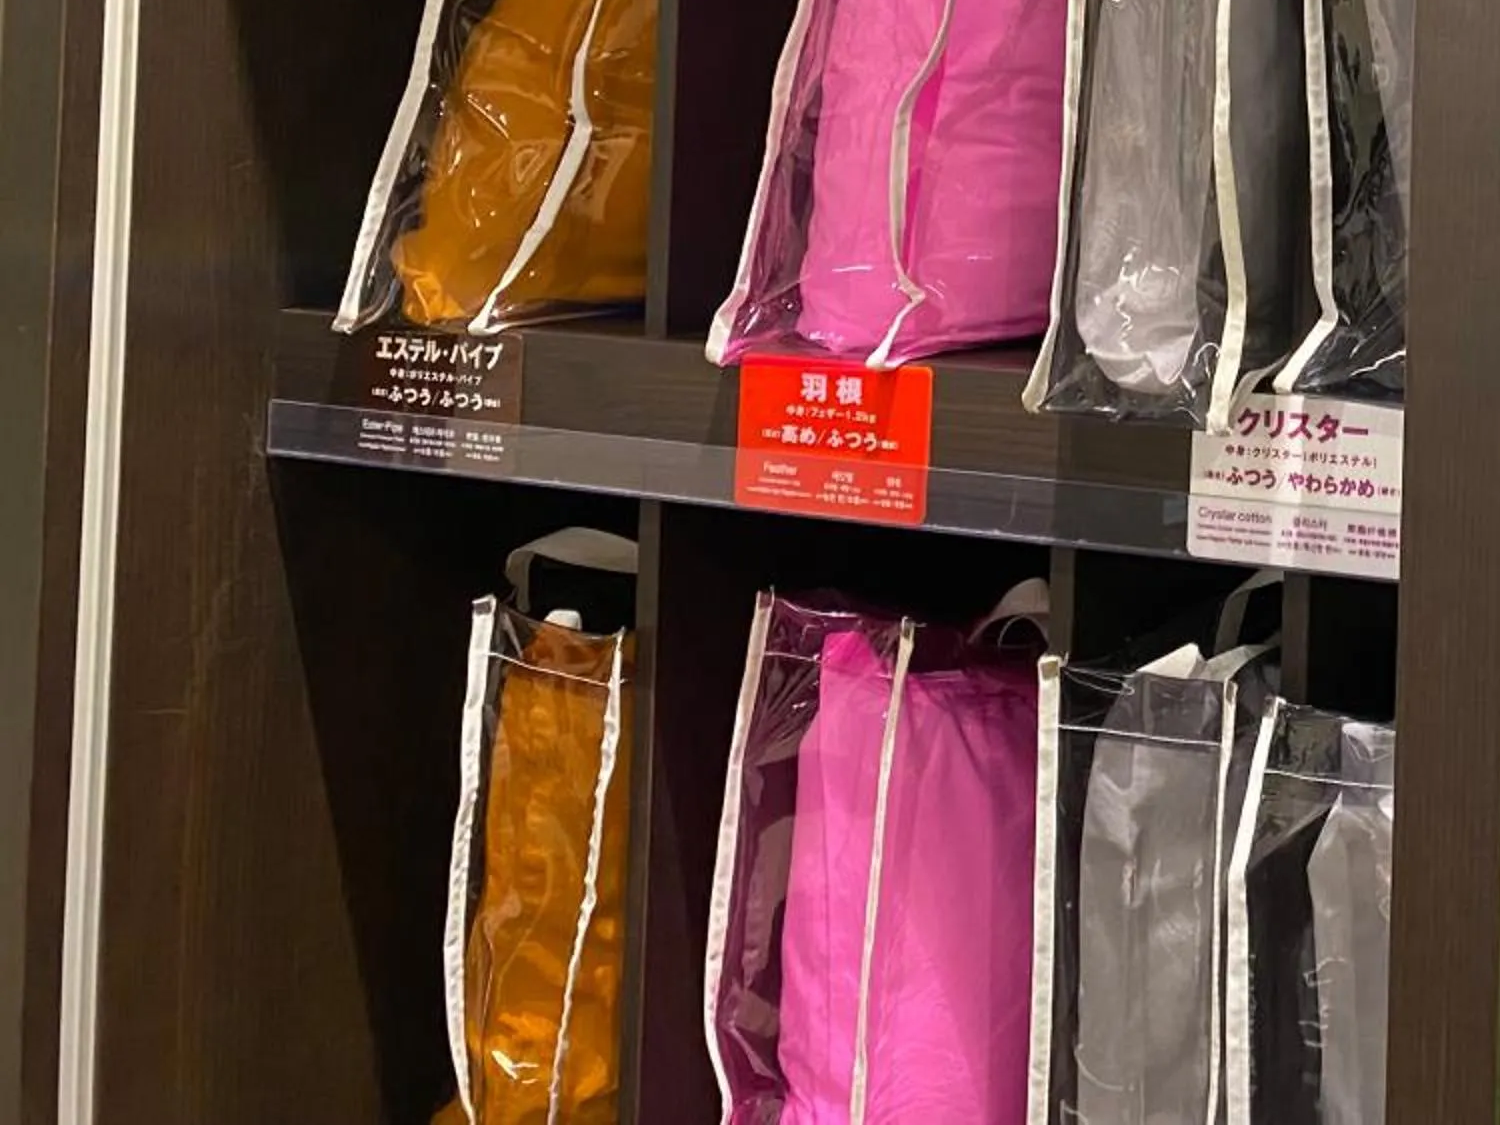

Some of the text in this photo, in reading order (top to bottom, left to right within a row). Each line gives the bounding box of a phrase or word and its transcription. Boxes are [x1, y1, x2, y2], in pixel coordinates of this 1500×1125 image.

[800, 372, 863, 405] 羽根
[1237, 407, 1369, 443] クリスター
